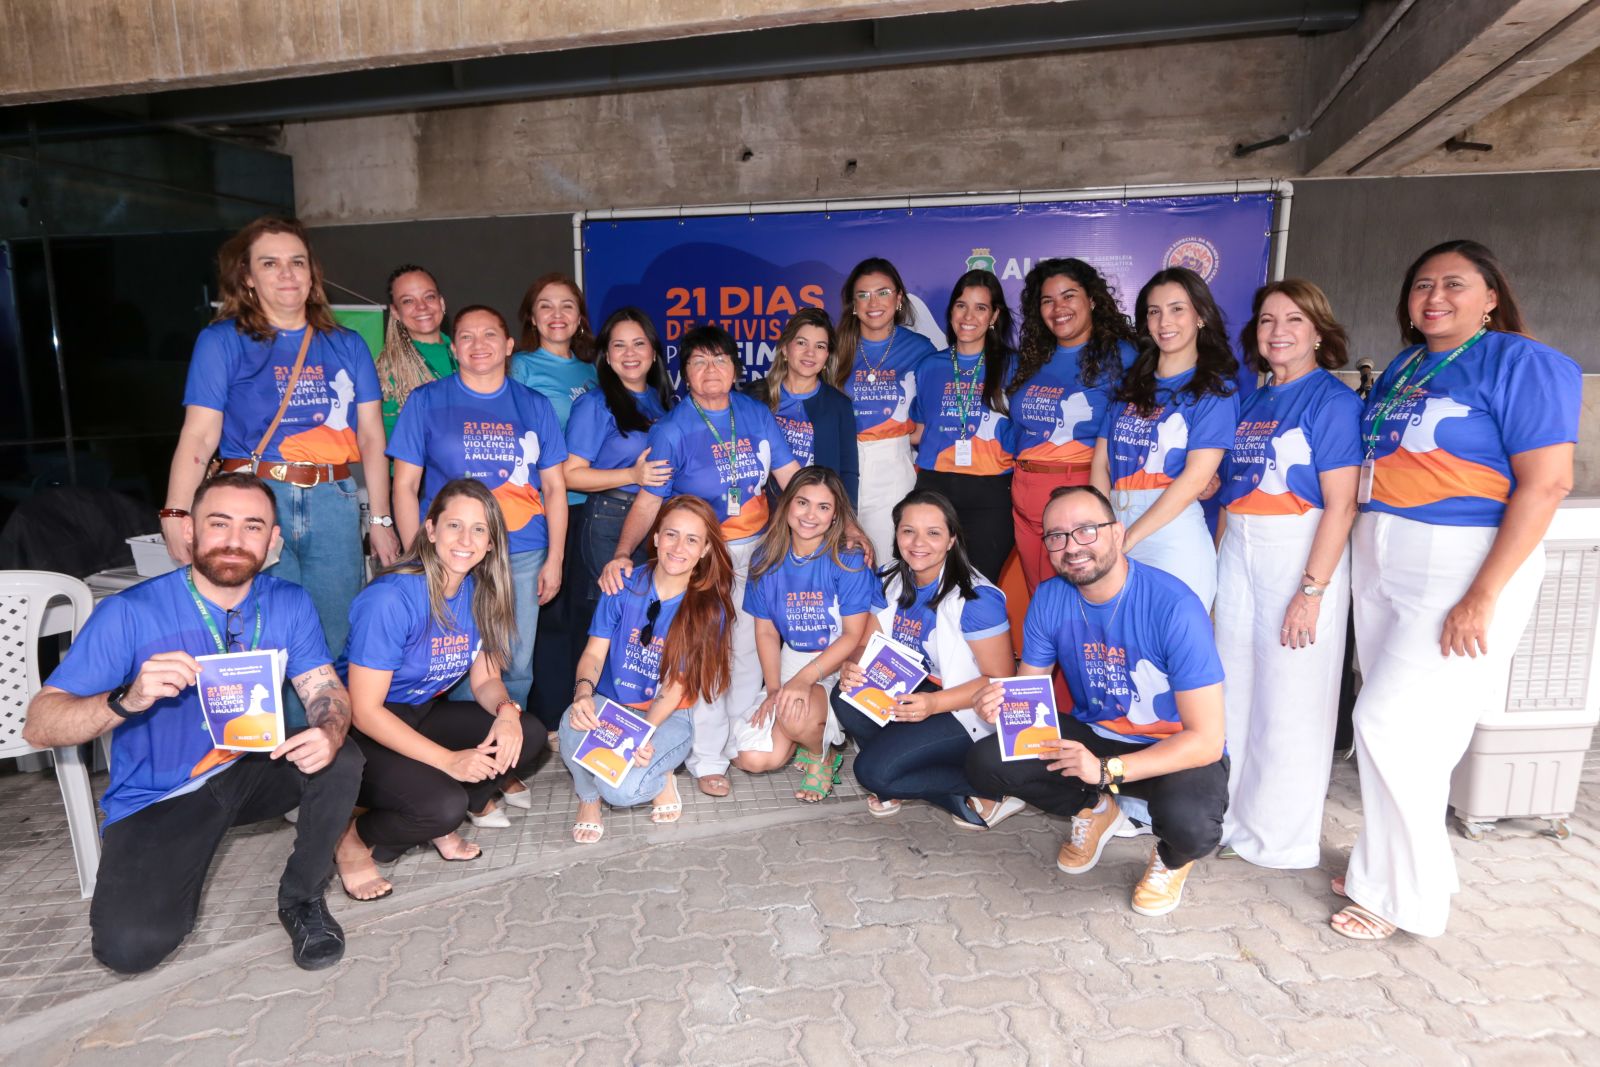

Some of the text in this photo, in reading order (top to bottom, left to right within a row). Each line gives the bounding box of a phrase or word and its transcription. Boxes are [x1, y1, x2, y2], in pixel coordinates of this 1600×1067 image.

[666, 284, 824, 316] 21 DIAS
[274, 366, 289, 374] 21
[1040, 386, 1064, 394] DIAS
[1238, 421, 1279, 430] 21 DIAS
[787, 430, 803, 439] FIM
[712, 444, 723, 453] 21
[800, 592, 823, 600] DIAS
[432, 634, 468, 648] 21 DIAS
[899, 633, 913, 643] FIM
[1084, 643, 1098, 652] 21
[446, 653, 460, 662] FIM
[642, 649, 658, 659] FIM
